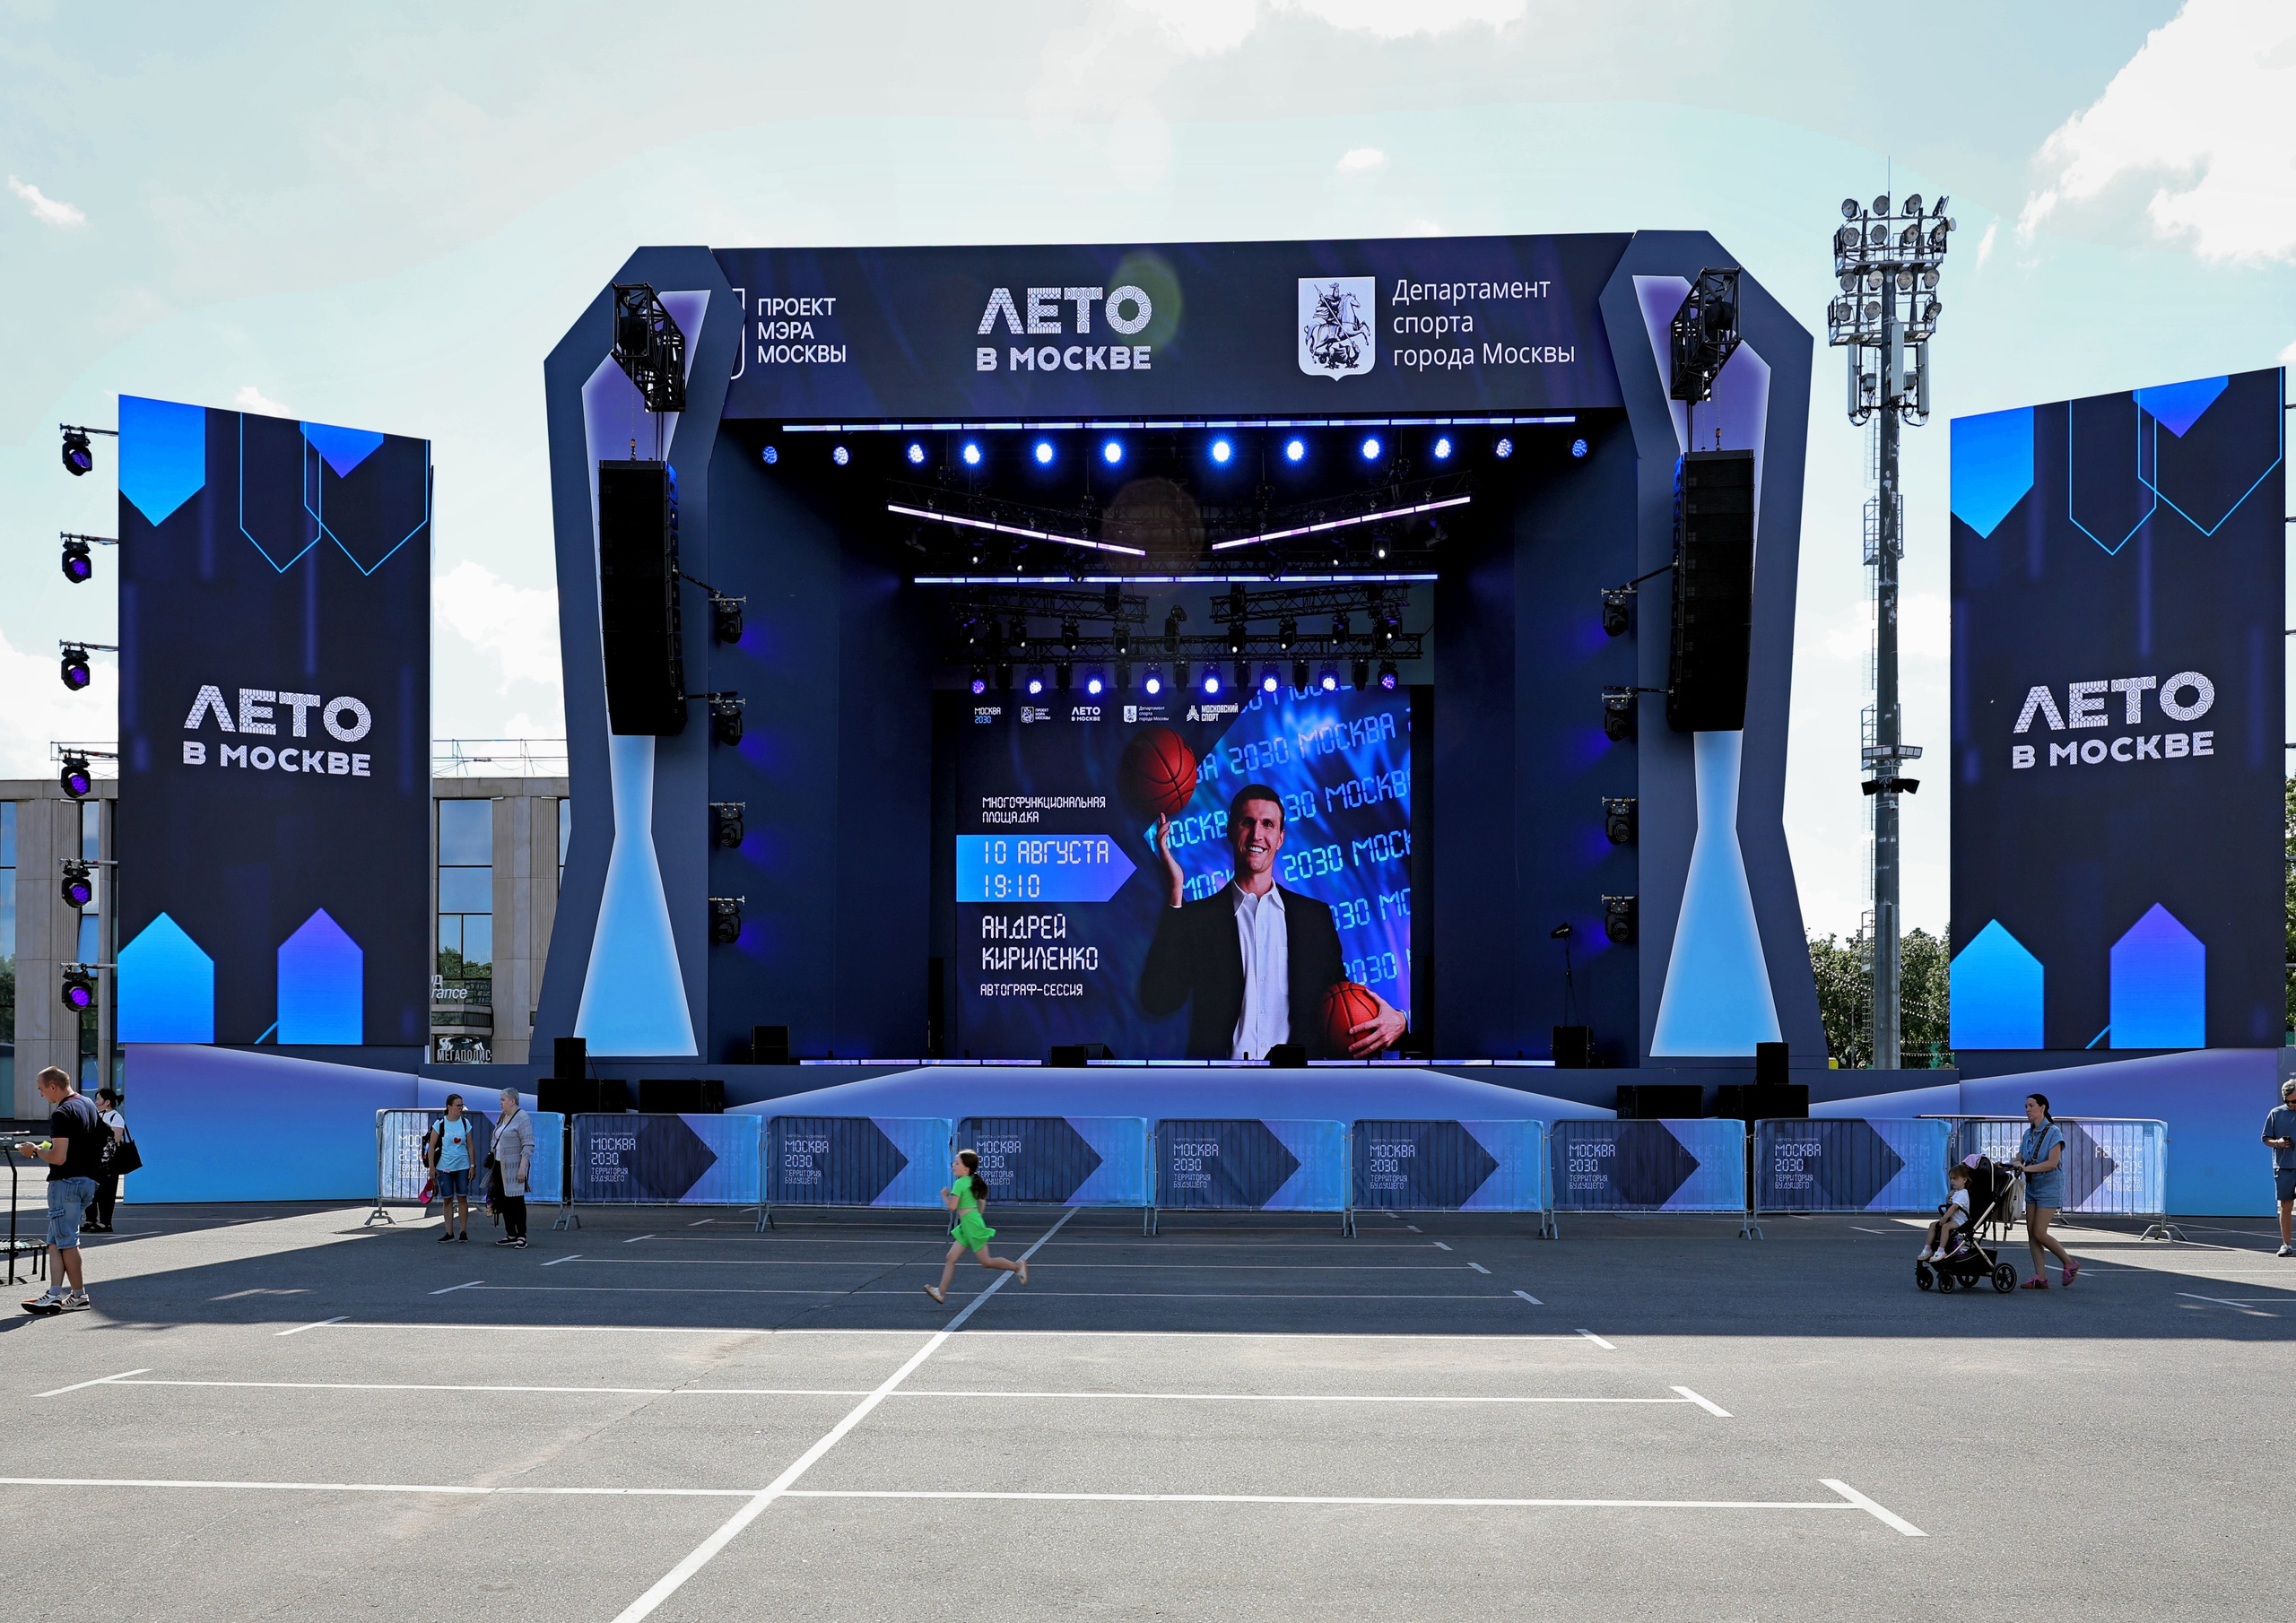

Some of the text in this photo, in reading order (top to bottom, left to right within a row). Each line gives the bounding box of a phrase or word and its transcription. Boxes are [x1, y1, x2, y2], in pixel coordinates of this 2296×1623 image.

[1392, 279, 1551, 306] Департамент
[758, 298, 836, 316] ПРОЕКТ
[977, 285, 1152, 334] ЛЕТО
[758, 321, 814, 340] МЭРА
[1393, 315, 1474, 339] спорта
[758, 344, 846, 363] МОСКВЫ
[976, 345, 1152, 371] В МОСКВЕ
[1394, 343, 1575, 372] города Москвы
[1201, 702, 1239, 714] МОСКОВСКИЙ
[2013, 671, 2215, 733] ЛЕТО
[183, 684, 372, 742] ЛЕТО
[974, 707, 1002, 716] МОСКВА
[1072, 707, 1101, 716] ЛЕТО
[1201, 713, 1220, 722] СПОРТ
[975, 716, 992, 724] 2030
[1228, 736, 1290, 775] 2030
[1298, 712, 1396, 759] МОСКВА
[2012, 731, 2214, 768] В МОСКВЕ
[183, 741, 370, 777] В МОСКВЕ
[1325, 768, 1410, 813] МОСКВ
[982, 796, 1106, 810] МНОГОФУНКЦИОНАЛЬНАЯ
[982, 812, 1039, 824] ПЛОЩАДКА
[985, 840, 1109, 864] 10 АВГУСТА
[1282, 844, 1344, 882] 2030
[985, 874, 1040, 898] 19:10
[982, 913, 1066, 939] АНДРЕЙ
[982, 947, 1098, 970] КИРИЛЕНКО
[980, 984, 1083, 996] АВТОГРАФ-СЕССИЯ
[591, 1138, 636, 1150] МОСКВА
[785, 1140, 830, 1153] МОСКВА
[976, 1141, 1022, 1154] МОСКВА
[1173, 1143, 1219, 1157] МОСКВА
[1370, 1144, 1415, 1158] МОСКВА
[1569, 1144, 1616, 1158] МОСКВА
[1775, 1143, 1822, 1157] МОСКВА
[591, 1152, 619, 1165] 2030
[785, 1154, 813, 1167] 2030
[978, 1155, 1004, 1168] 2030
[1173, 1158, 1202, 1171] 2030
[1370, 1159, 1398, 1172] 2030
[1569, 1159, 1598, 1172] 2030
[1775, 1159, 1804, 1172] 2030
